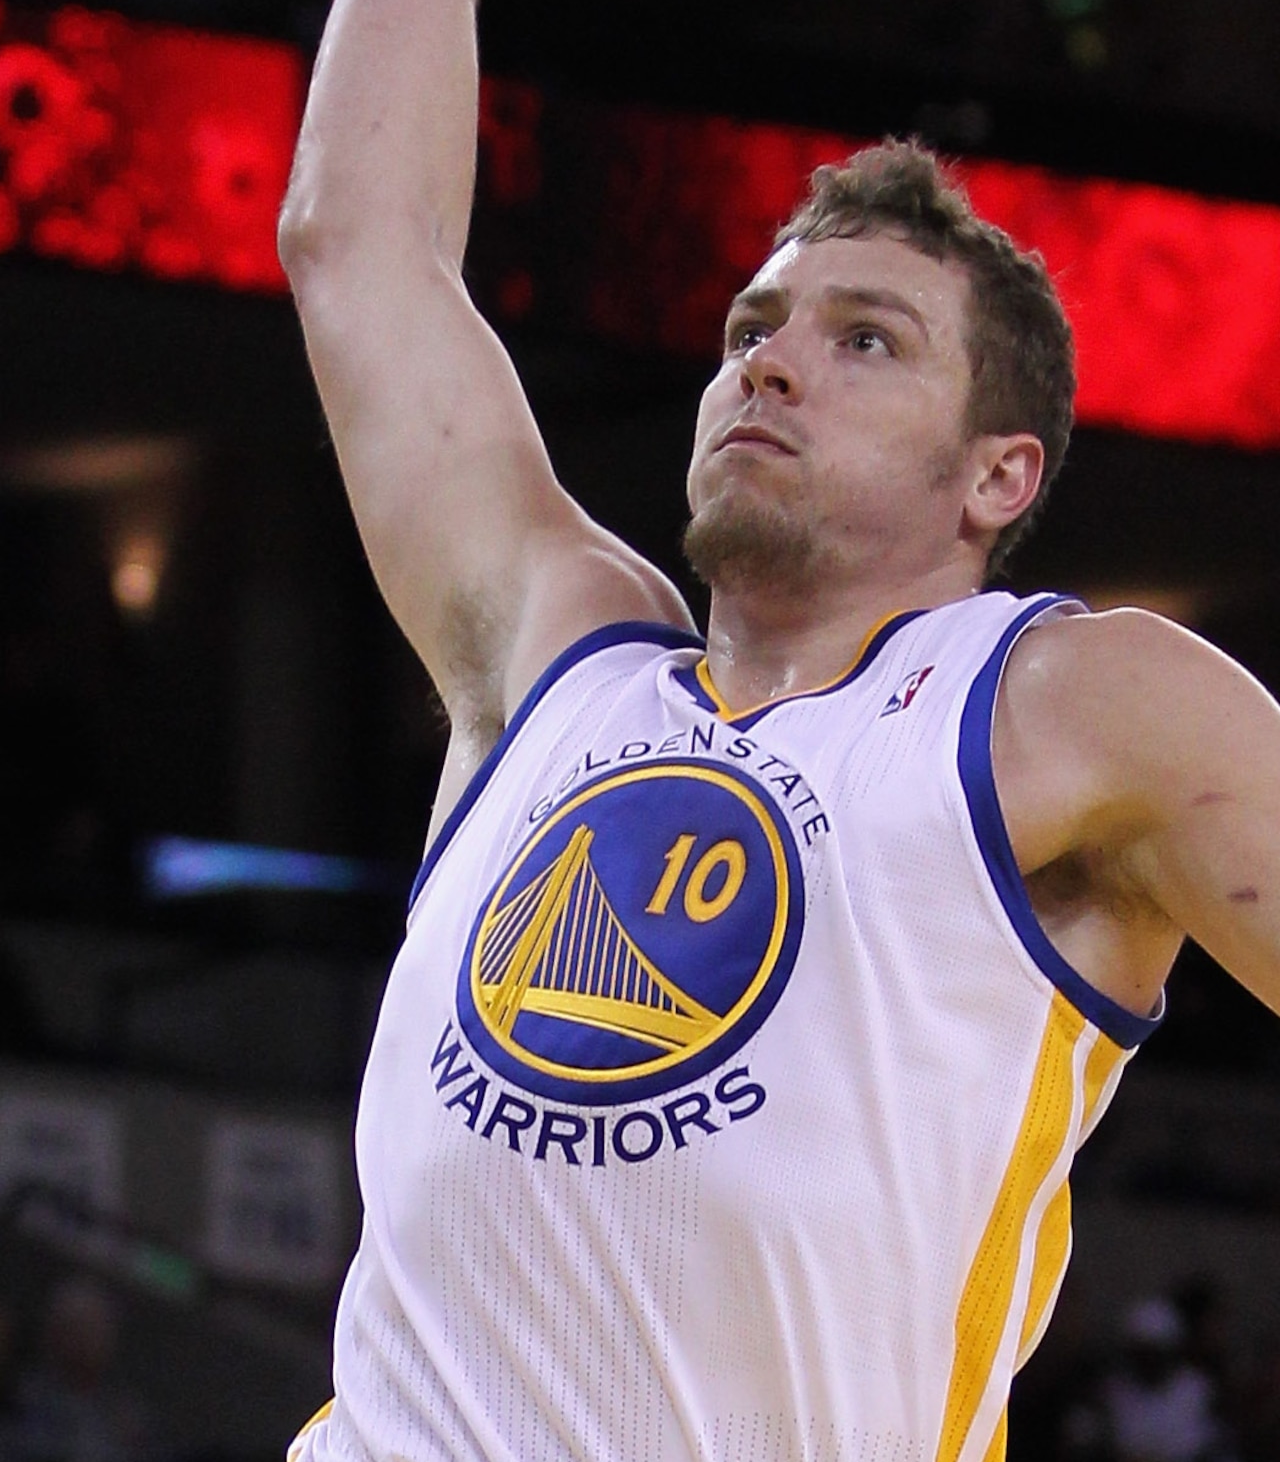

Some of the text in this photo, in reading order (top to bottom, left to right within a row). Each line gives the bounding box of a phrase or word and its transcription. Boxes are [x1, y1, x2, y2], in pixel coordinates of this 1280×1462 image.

[725, 737, 832, 847] STATE
[644, 832, 747, 925] 10
[429, 1020, 767, 1168] WARRIORS
